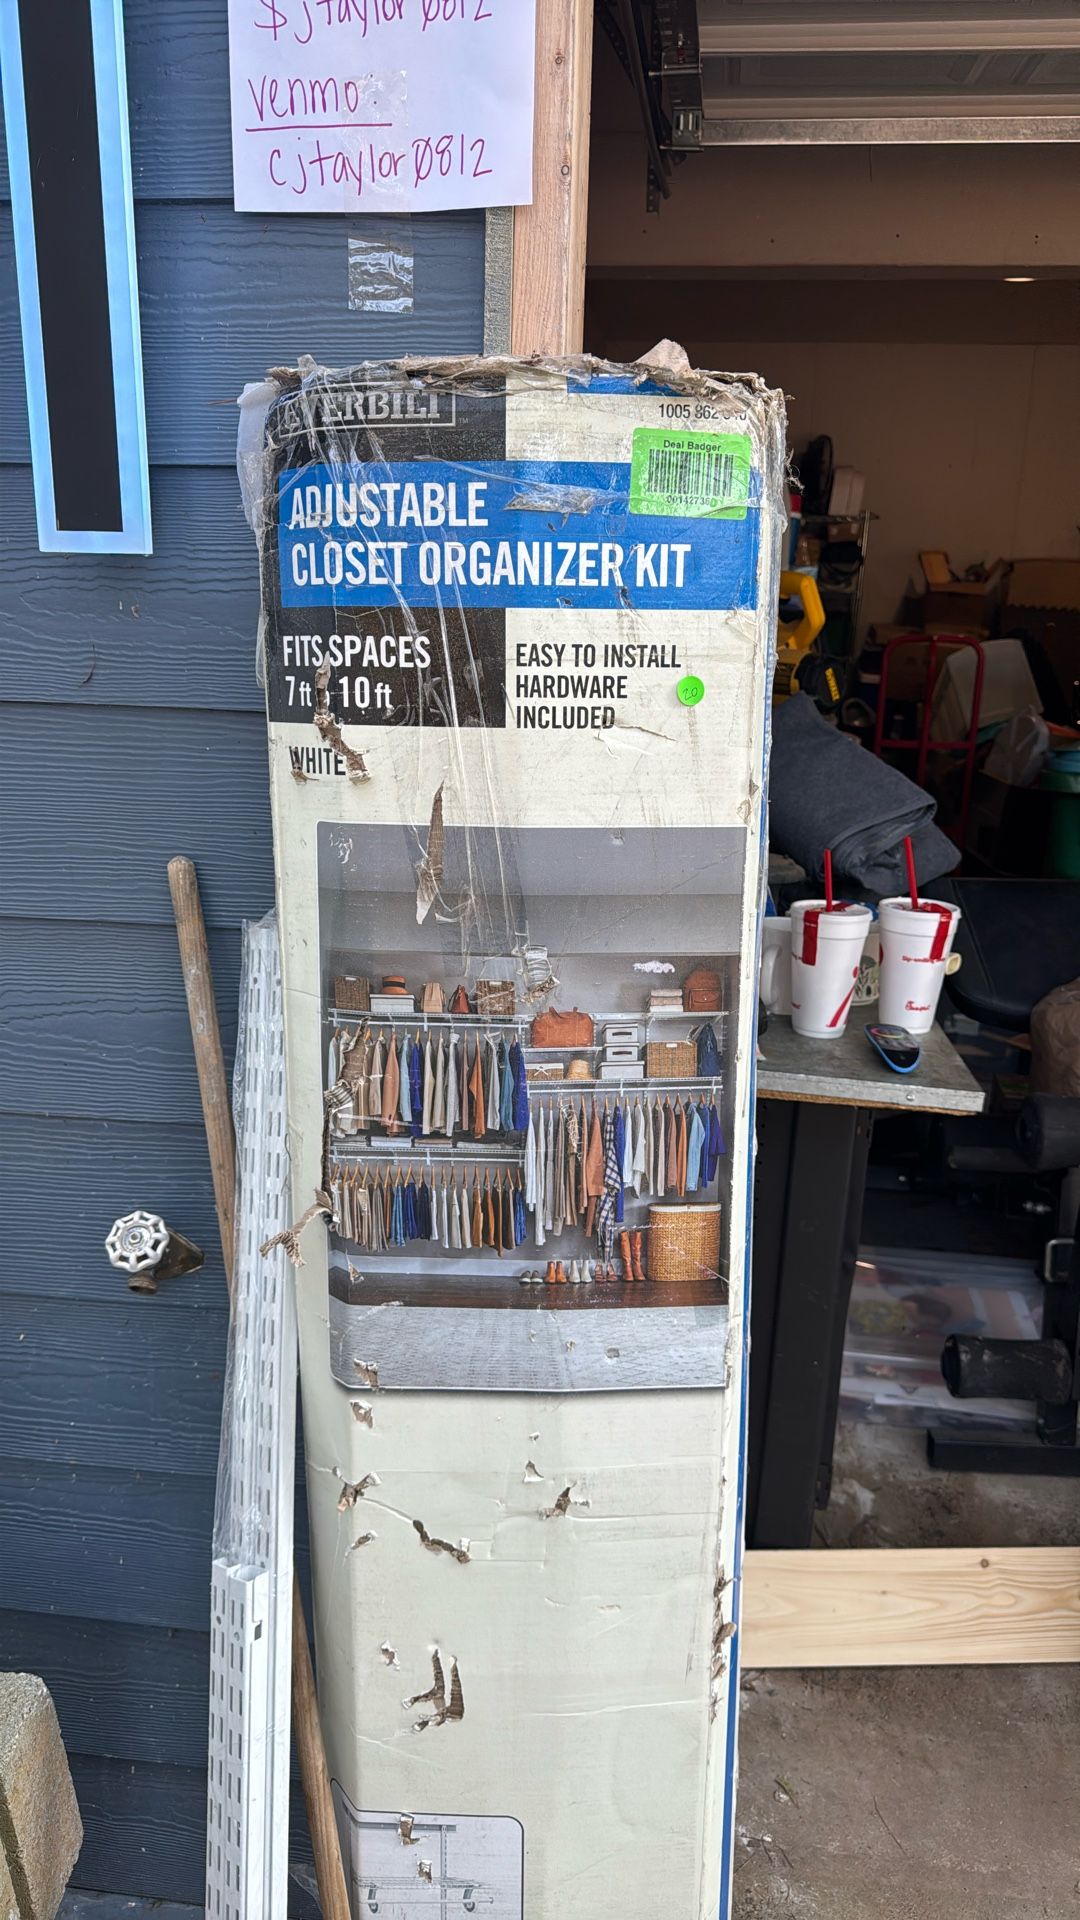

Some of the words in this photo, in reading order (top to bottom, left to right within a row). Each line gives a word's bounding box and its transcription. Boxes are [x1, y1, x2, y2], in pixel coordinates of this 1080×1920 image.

[659, 404, 691, 419] 1005
[663, 439, 685, 449] Deal
[687, 441, 722, 453] Badger
[289, 481, 489, 530] ADJUSTABLE
[291, 541, 408, 587] CLOSET
[418, 540, 624, 587] ORGANIZER
[635, 542, 692, 588] KIT
[282, 635, 323, 667] FITS
[329, 635, 431, 669] SPACES
[516, 643, 567, 667] EASY
[571, 644, 597, 668] TO
[603, 644, 682, 668] INSTALL
[515, 674, 629, 699] HARDWARE
[515, 705, 616, 730] INCLUDED
[288, 745, 347, 776] WHITE
